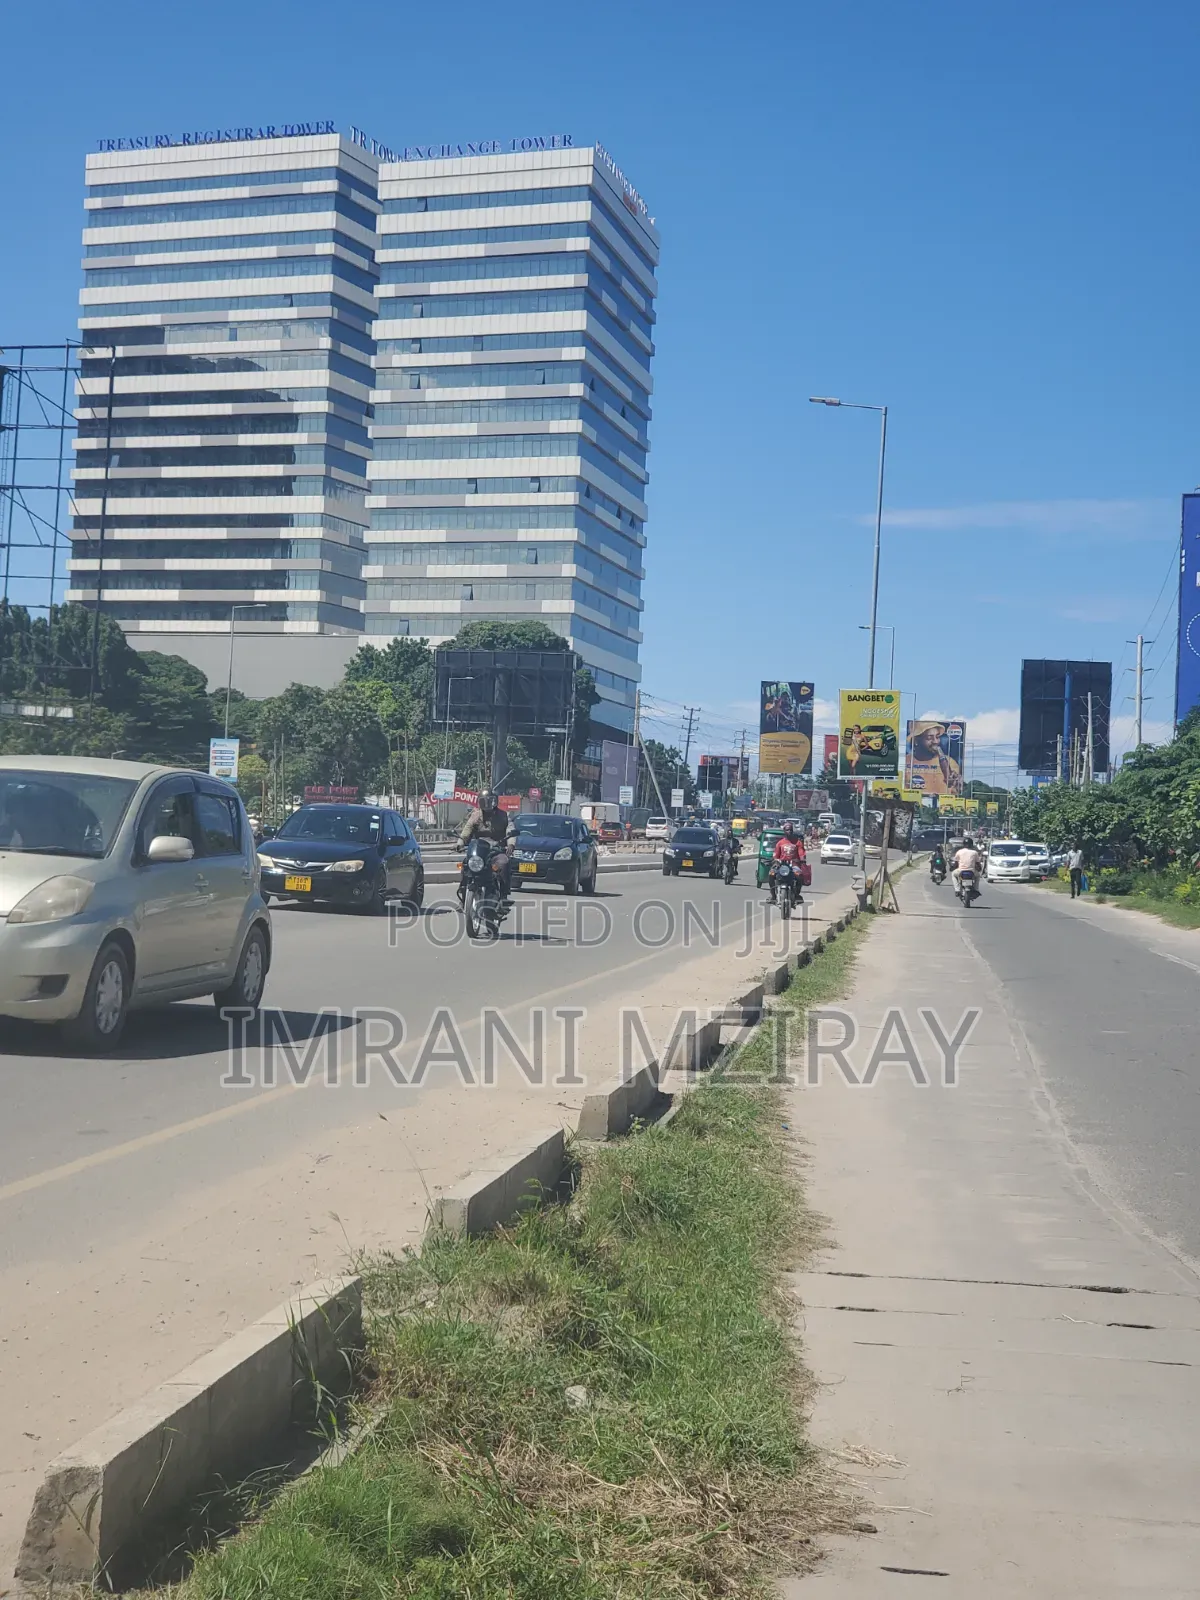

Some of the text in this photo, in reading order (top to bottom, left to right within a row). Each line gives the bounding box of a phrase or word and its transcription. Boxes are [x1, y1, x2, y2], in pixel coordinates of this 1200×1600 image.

[97, 120, 336, 151] TREASURY REGISTRAR TOWER
[350, 125, 403, 163] TR TOW
[403, 133, 574, 161] EXCHANGE TOWER
[847, 694, 885, 702] BANGBET
[454, 791, 478, 804] POINT
